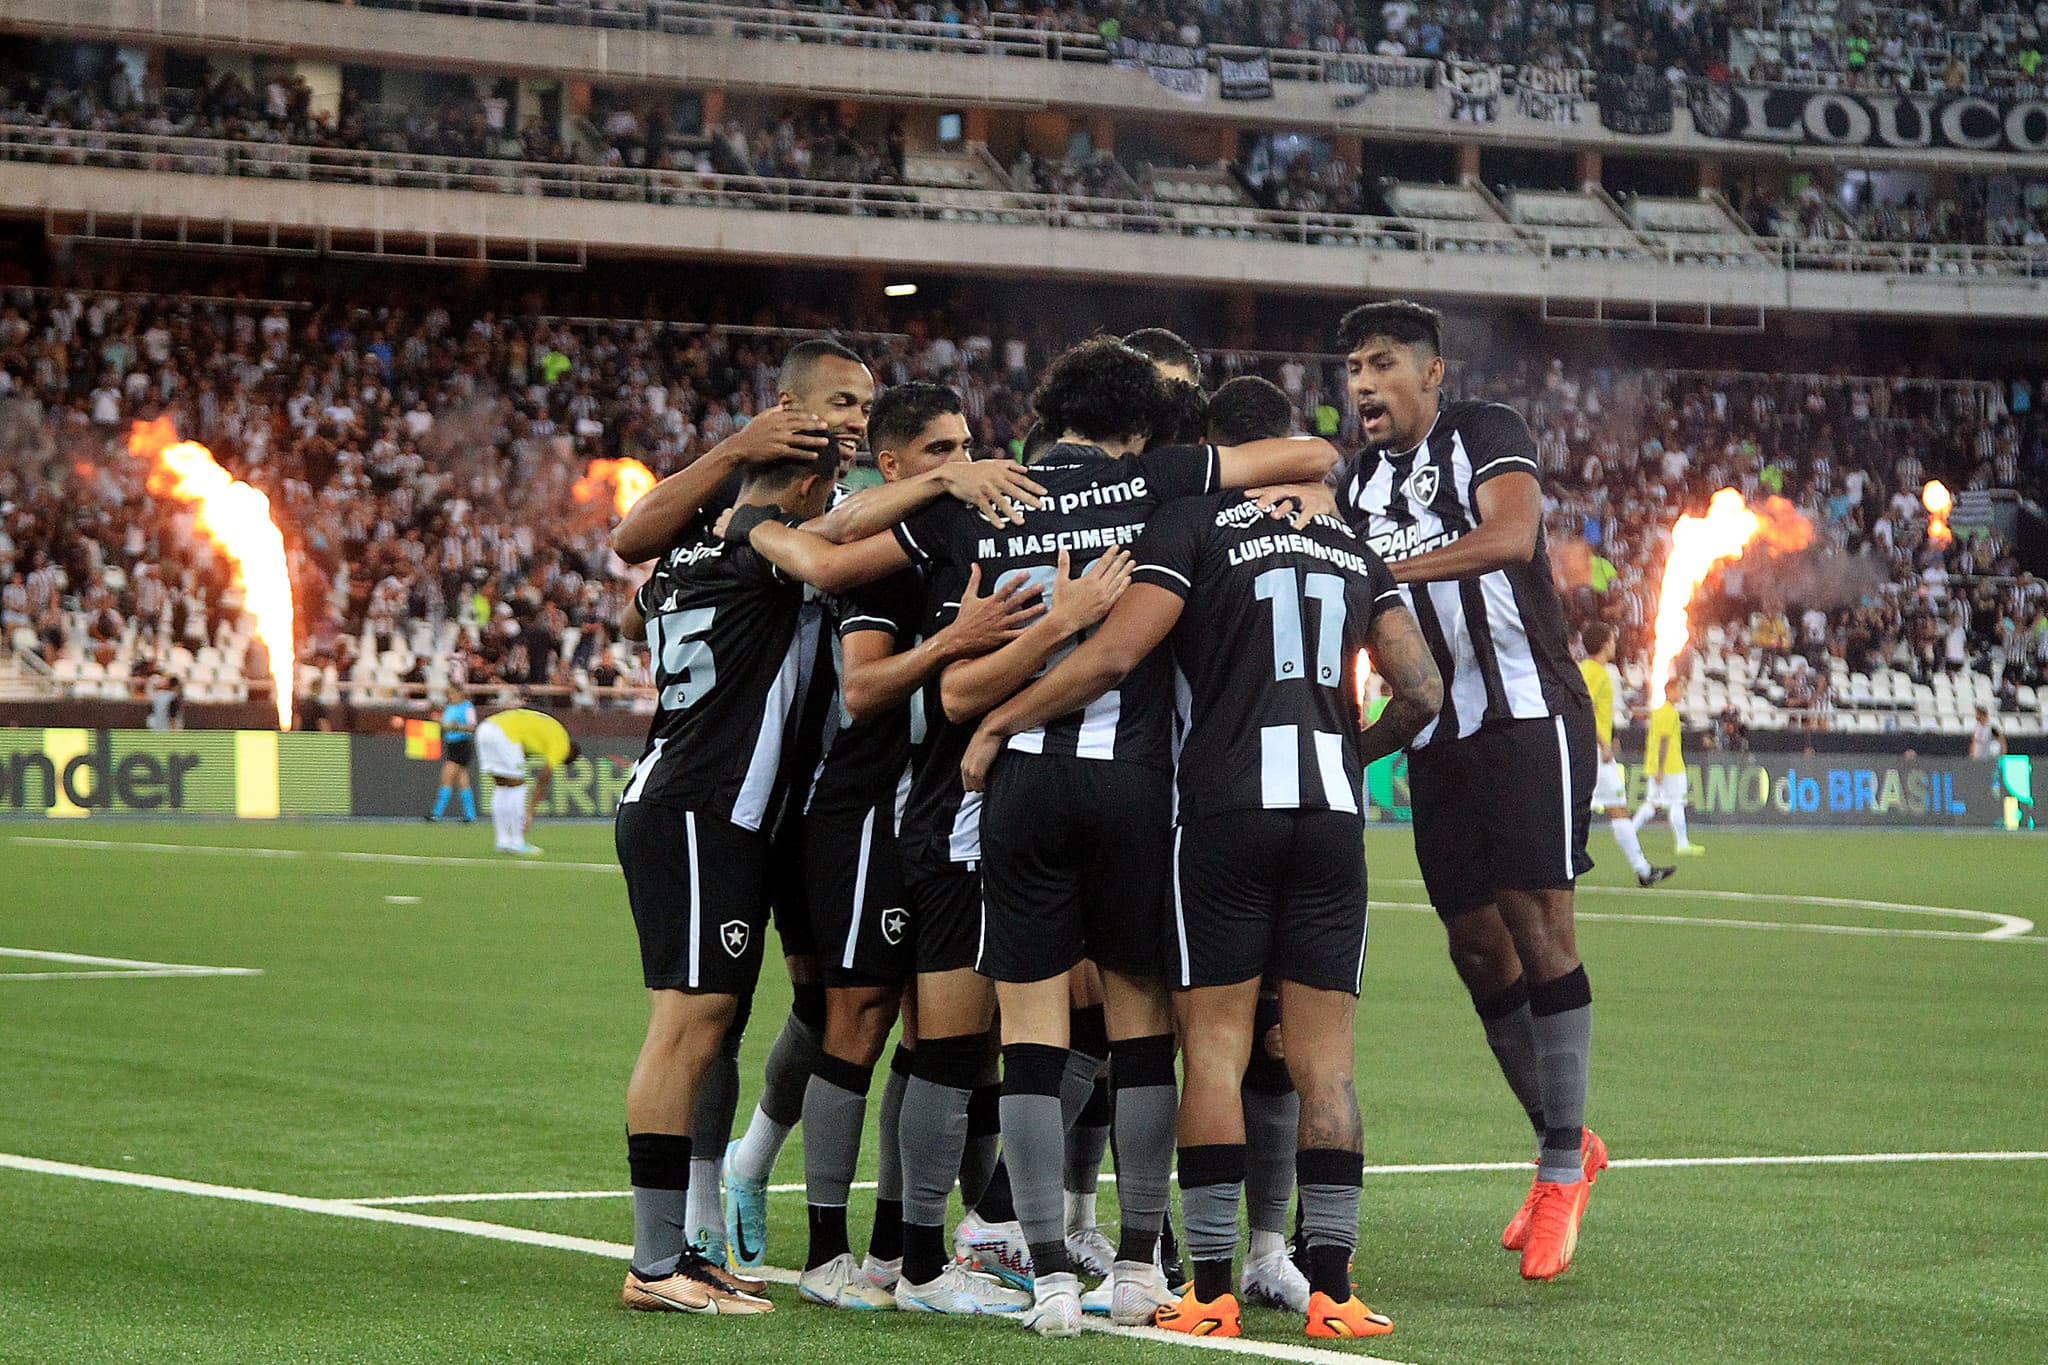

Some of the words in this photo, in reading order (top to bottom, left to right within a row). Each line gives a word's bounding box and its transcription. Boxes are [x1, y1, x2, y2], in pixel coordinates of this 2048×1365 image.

[1060, 476, 1148, 514] prime
[978, 538, 1002, 559] M.
[1008, 523, 1146, 557] NASCIMENT
[0, 727, 200, 808] nder
[1775, 767, 1820, 813] do
[1827, 768, 1967, 815] BRASIL
